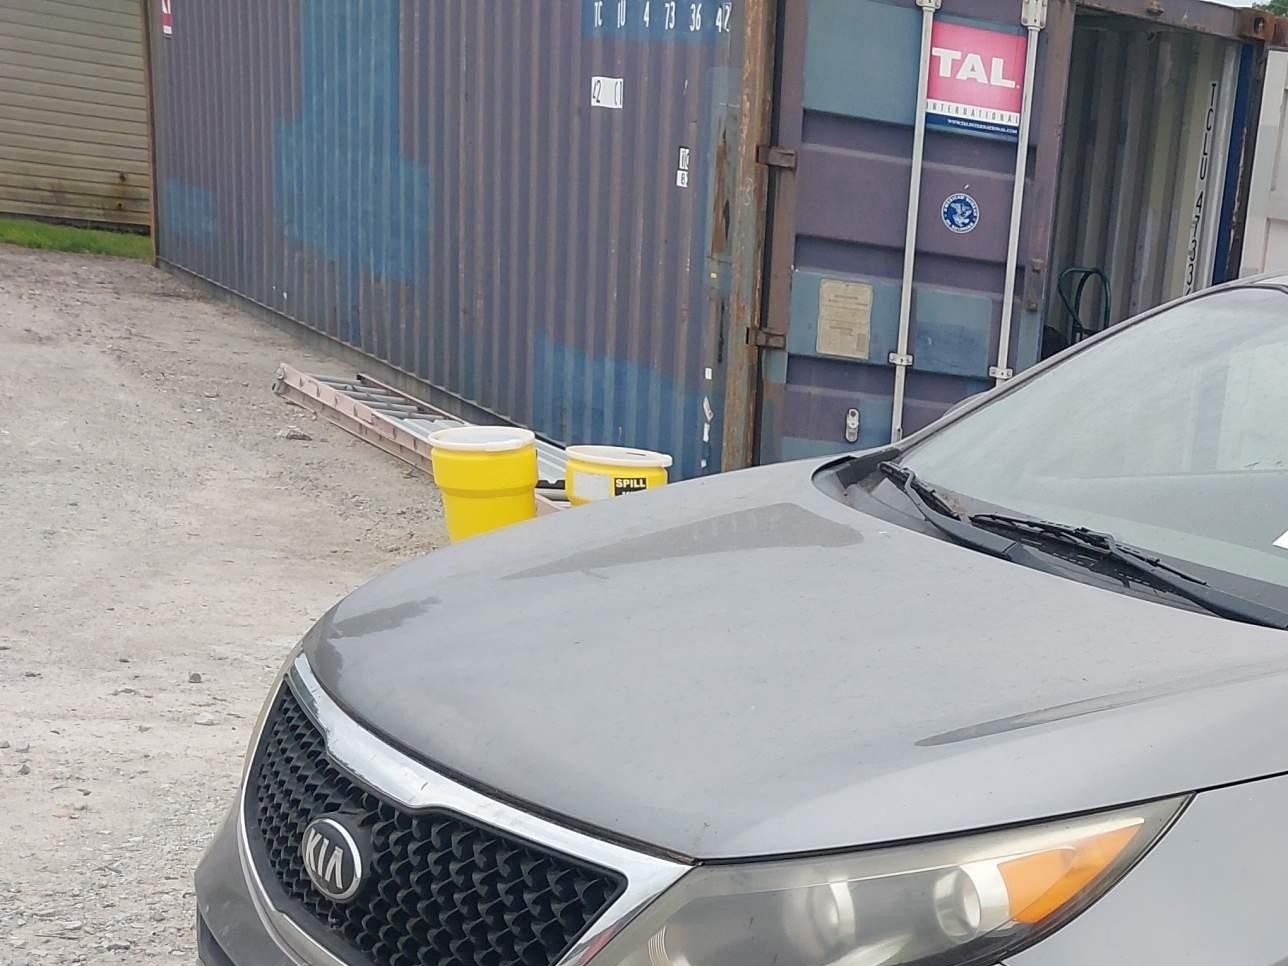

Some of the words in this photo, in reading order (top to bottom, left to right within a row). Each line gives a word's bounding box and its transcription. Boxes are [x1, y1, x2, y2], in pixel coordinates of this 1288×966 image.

[688, 3, 703, 32] 36
[615, 478, 646, 488] SPILL
[305, 826, 344, 890] KIA
